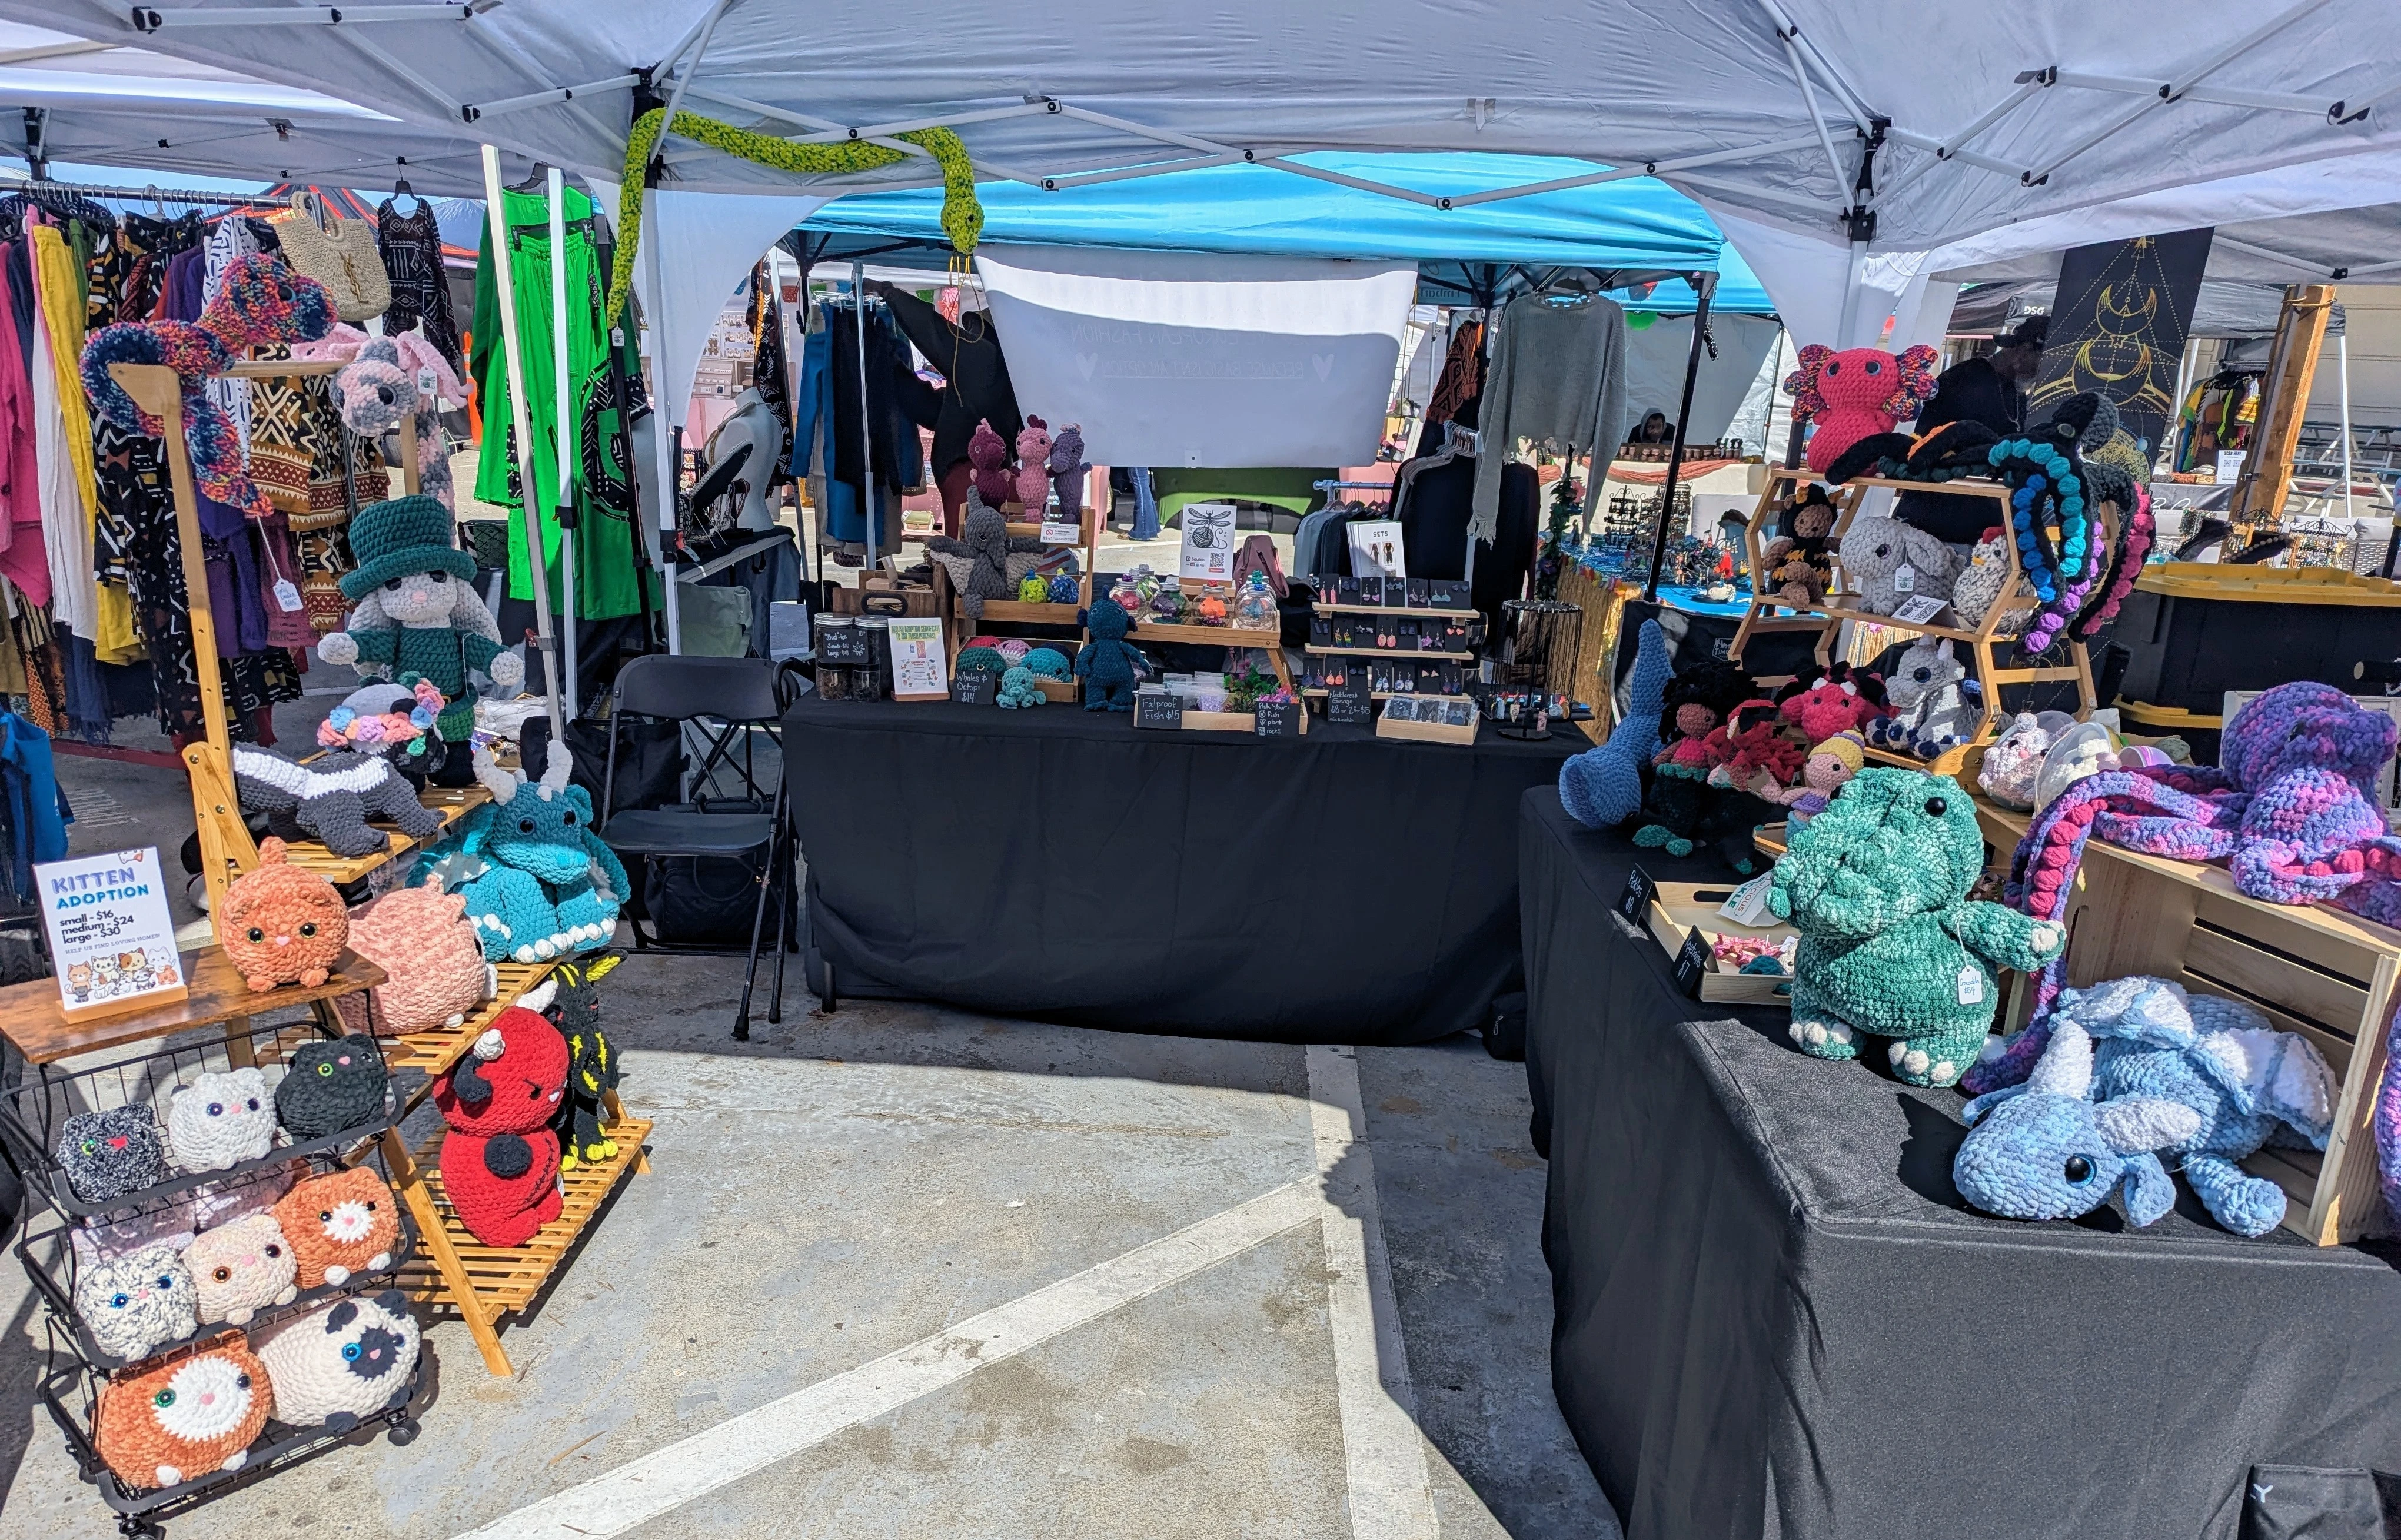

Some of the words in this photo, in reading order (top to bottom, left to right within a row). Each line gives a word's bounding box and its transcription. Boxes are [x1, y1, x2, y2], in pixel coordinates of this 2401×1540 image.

[2023, 305, 2045, 315] DSG
[956, 671, 980, 682] Whales
[957, 681, 980, 692] Octopi
[961, 691, 975, 704] $14
[1142, 697, 1178, 710] Failproof
[1145, 710, 1165, 720] Fish
[1166, 710, 1180, 721] $15
[1331, 705, 1340, 714] $8
[1348, 706, 1354, 714] 2
[51, 867, 135, 894] KITTEN
[1628, 869, 1642, 898] Pickles
[56, 884, 150, 910] ADOPTION
[1625, 896, 1635, 913] $8
[59, 913, 87, 927] small
[96, 909, 114, 922] $16
[61, 922, 105, 936] medium
[114, 914, 134, 927] $24
[62, 933, 92, 945] large
[99, 926, 121, 939] $30
[65, 947, 82, 955] HELP
[94, 942, 110, 950] FIND
[111, 937, 137, 947] LOVING
[1960, 976, 1980, 986] Crocodile
[1964, 986, 1976, 996] $54
